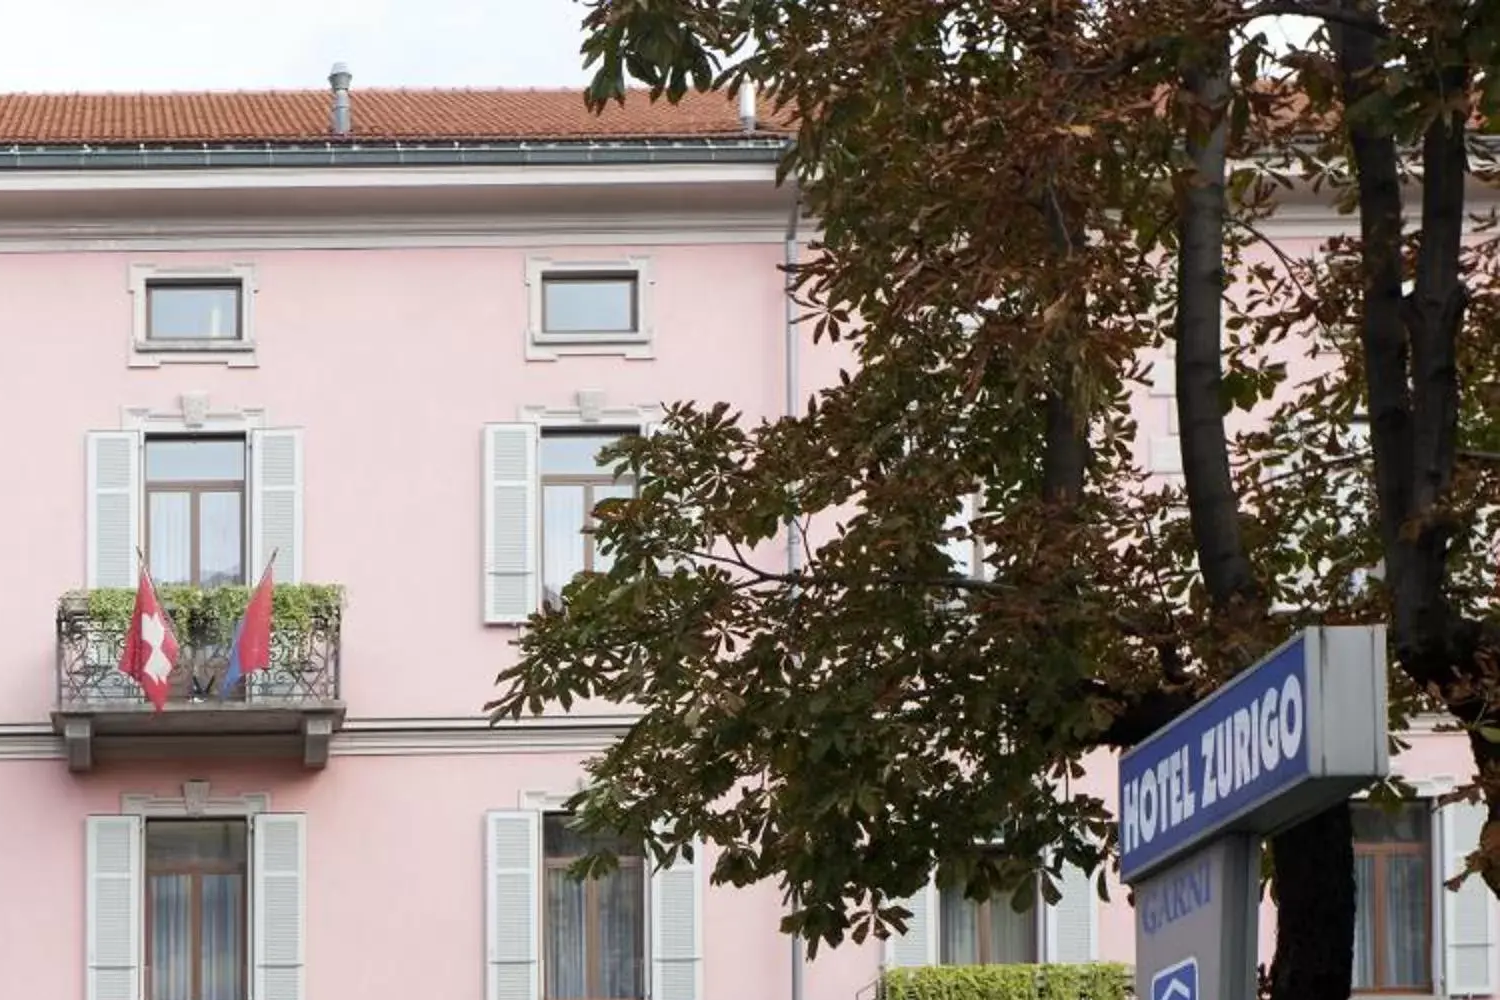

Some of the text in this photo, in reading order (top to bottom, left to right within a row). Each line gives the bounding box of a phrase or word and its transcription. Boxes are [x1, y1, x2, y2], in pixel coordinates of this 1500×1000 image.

[1124, 674, 1303, 854] HOTEL ZURIGO
[1142, 857, 1213, 935] GARNI
